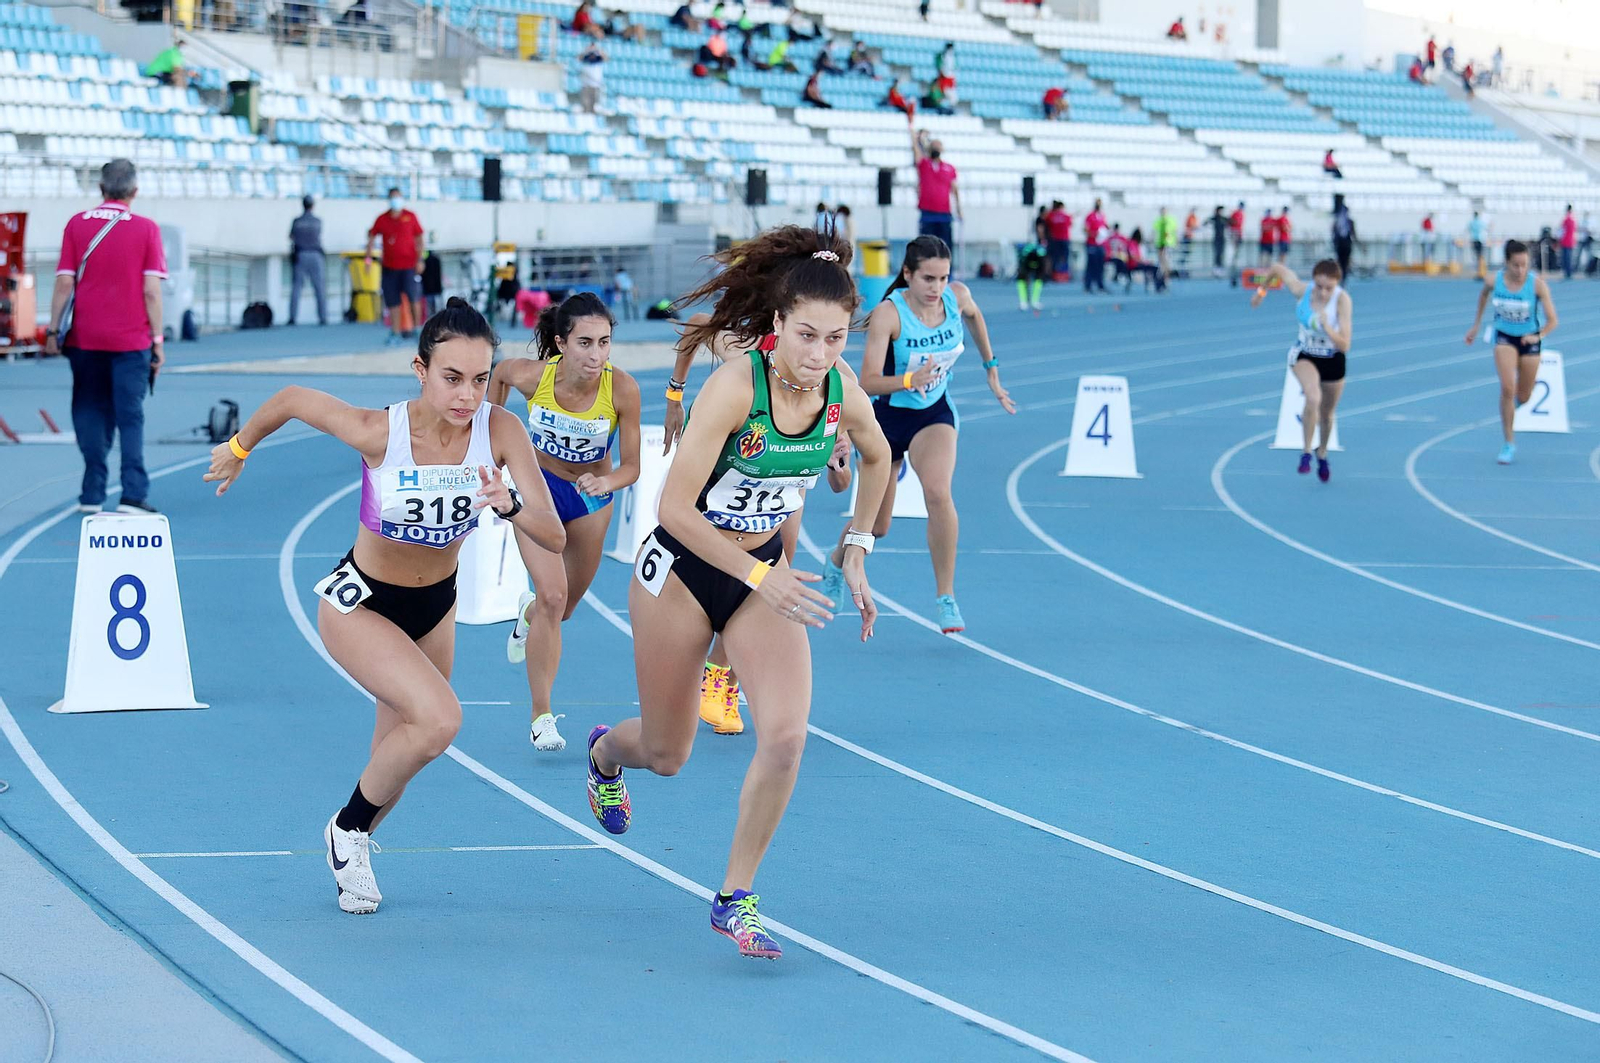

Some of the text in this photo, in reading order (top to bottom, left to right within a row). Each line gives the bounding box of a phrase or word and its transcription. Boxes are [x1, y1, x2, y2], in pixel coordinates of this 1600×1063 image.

[906, 329, 954, 348] nerja
[1531, 380, 1550, 415] 2
[1086, 404, 1112, 446] 4
[536, 437, 599, 462] Joma
[543, 429, 591, 450] 312
[769, 443, 814, 453] VILLARREAL
[439, 475, 477, 484] HUELVA
[404, 496, 472, 524] 318
[89, 535, 163, 548] MONDO
[390, 522, 471, 543] Joma
[641, 547, 663, 582] 6
[324, 571, 362, 607] 10
[107, 574, 151, 661] 8
